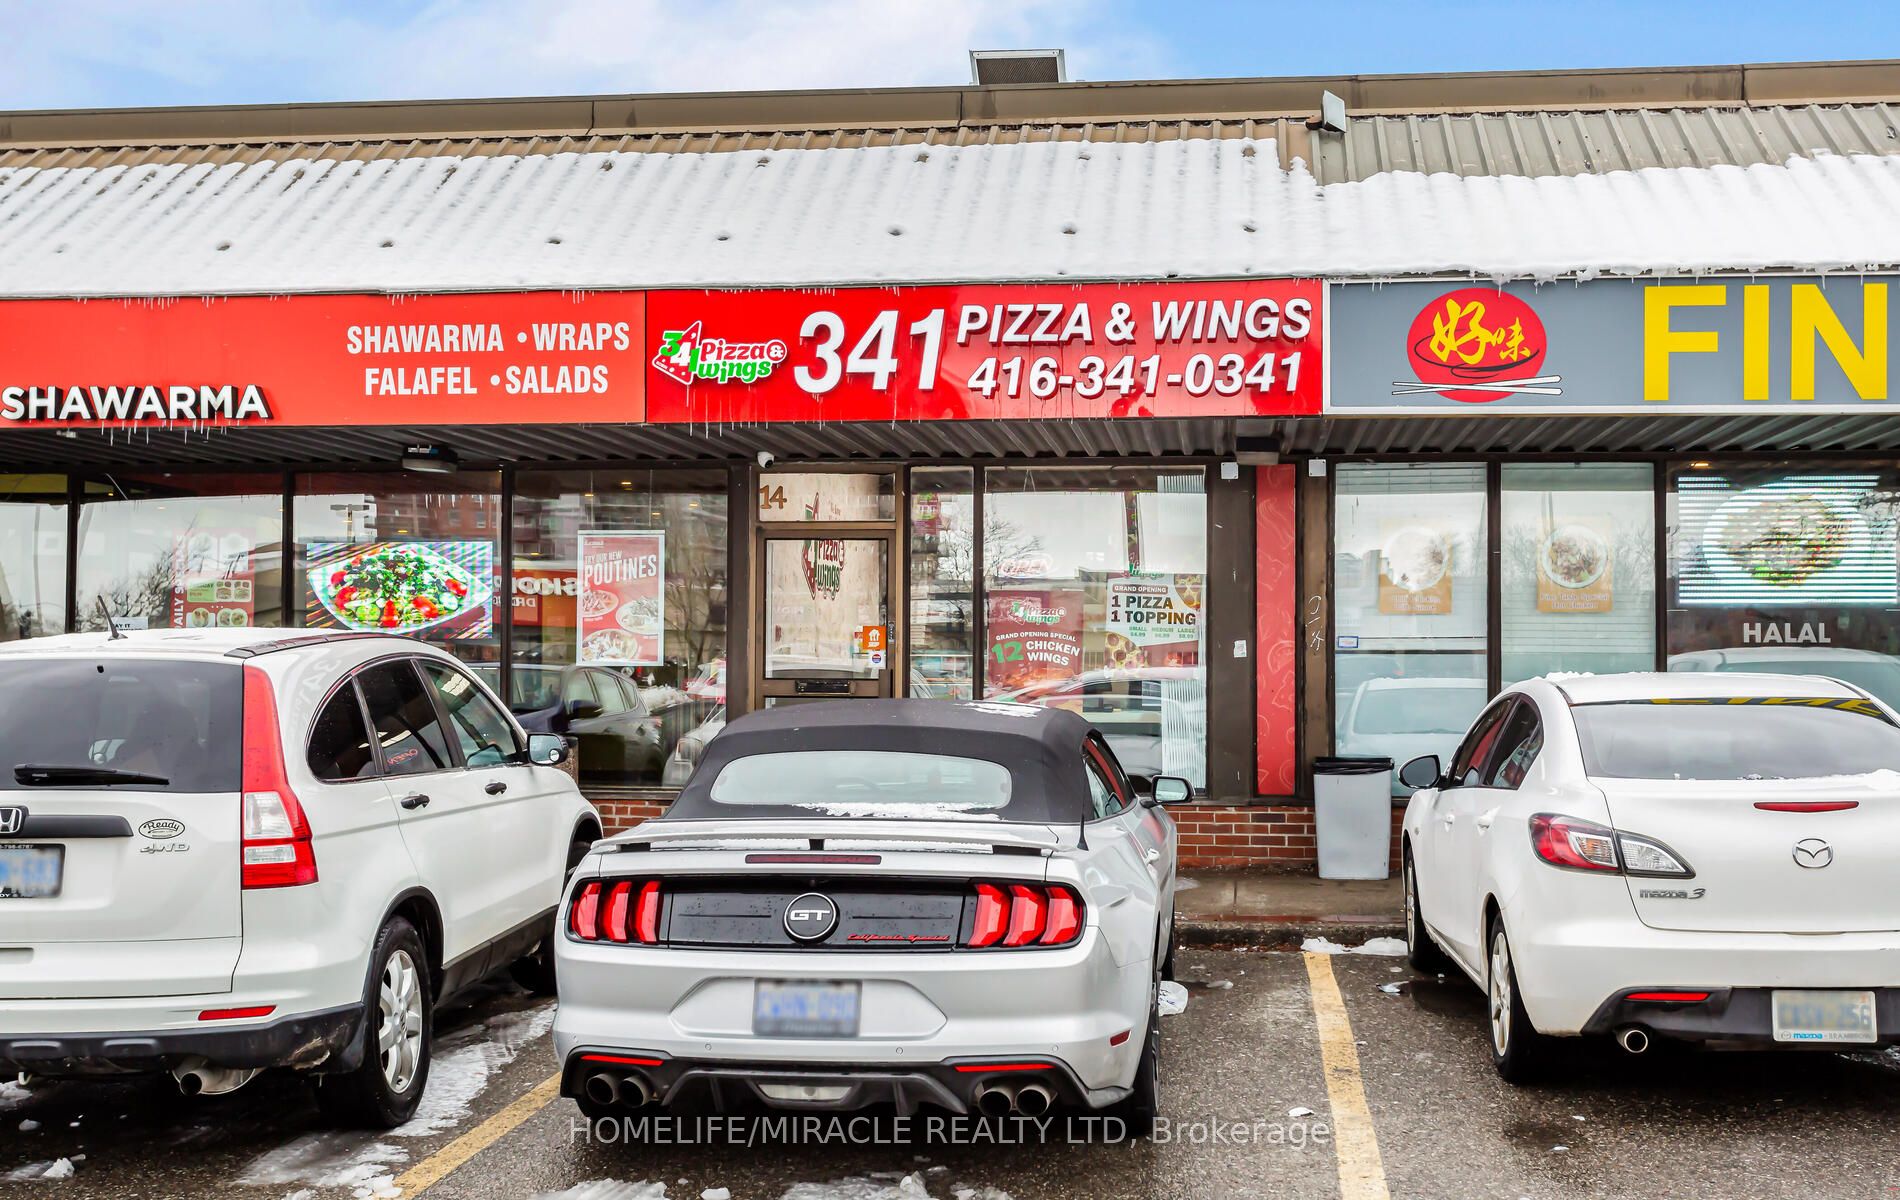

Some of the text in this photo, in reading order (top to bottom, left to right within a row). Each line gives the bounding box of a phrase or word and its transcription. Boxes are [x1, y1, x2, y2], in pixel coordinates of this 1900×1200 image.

[957, 298, 1313, 344] PIZZA & WINGS
[1429, 298, 1532, 365] 好味
[347, 321, 631, 354] SHAWARMA WRAPS
[1644, 283, 1888, 401] FIN
[660, 331, 701, 373] 341
[700, 341, 785, 361] Pizza &
[794, 308, 946, 394] 341
[365, 365, 609, 396] FALAFEL SALADS
[698, 361, 772, 383] wings
[967, 352, 1302, 399] 416-341-0341
[0, 385, 271, 421] SHAWARMA
[759, 484, 787, 509] 14
[584, 555, 657, 587] POUTINES
[1111, 595, 1173, 609] 1 PIZZA
[1111, 610, 1196, 625] 1 TOPPING
[996, 632, 1019, 640] GRAND
[1050, 632, 1077, 641] SPECIAL
[1743, 622, 1832, 643] HALAL
[991, 641, 1025, 663] 12
[1025, 641, 1081, 656] CHICKEN
[1027, 652, 1070, 666] WINGS
[144, 821, 180, 832] Ready
[790, 909, 831, 921] GT
